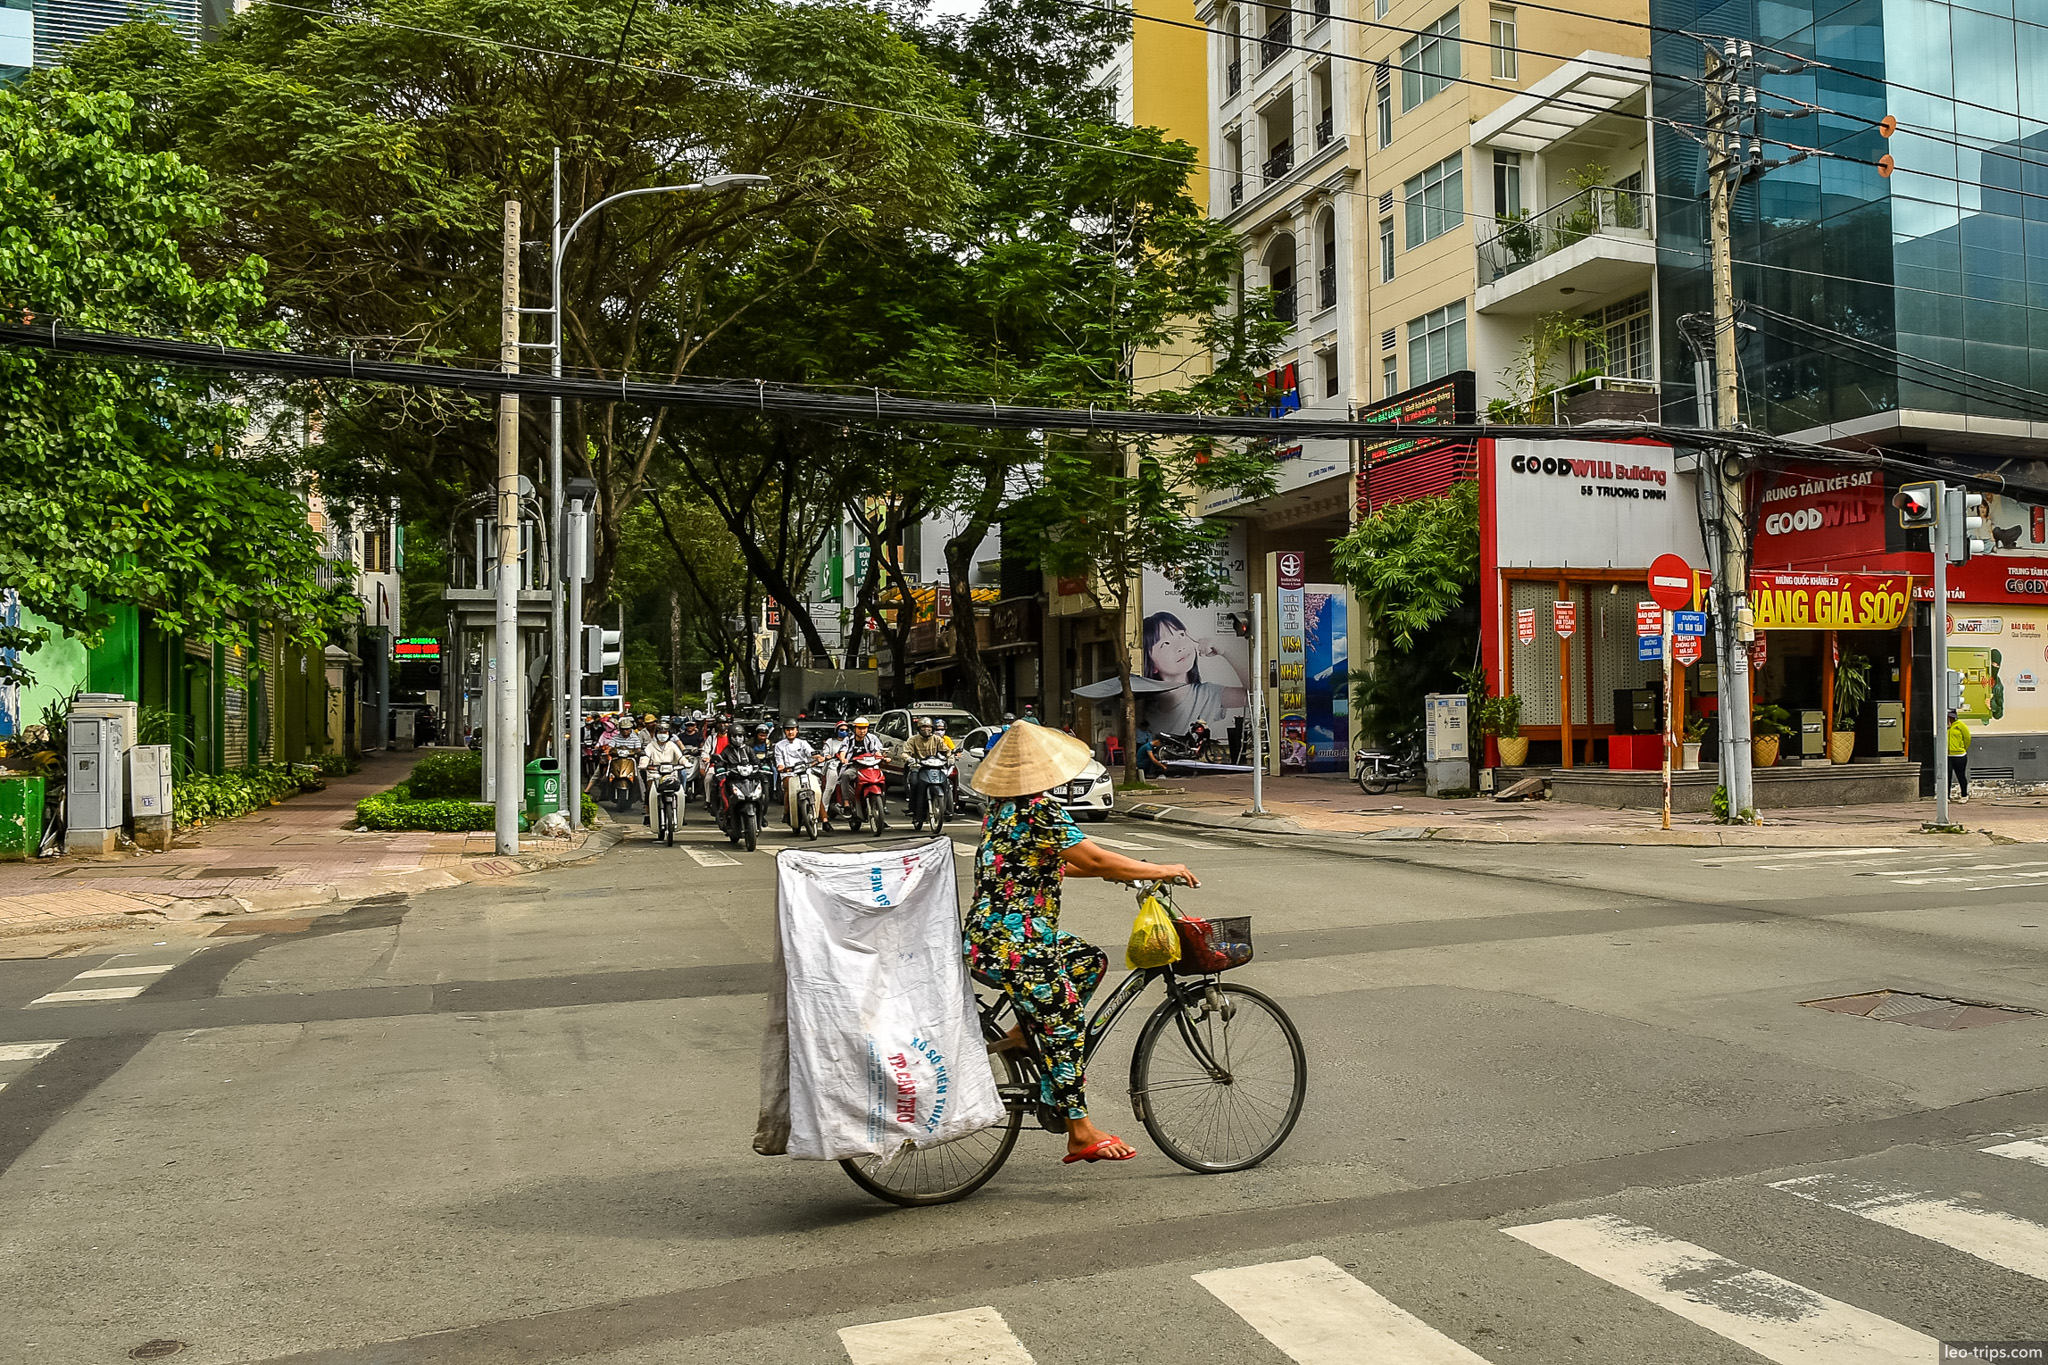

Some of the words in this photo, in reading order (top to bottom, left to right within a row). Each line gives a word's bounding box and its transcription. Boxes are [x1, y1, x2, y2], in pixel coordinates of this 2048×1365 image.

[1511, 455, 1613, 479] GOODWILL
[1615, 464, 1667, 486] Building
[1580, 485, 1593, 496] 55
[1596, 486, 1639, 499] TRUONG
[1642, 489, 1667, 500] DINH
[1765, 501, 1867, 535] GOODWILL
[1814, 583, 1854, 624] GIÁ
[1859, 580, 1904, 624] SỐC
[1281, 635, 1303, 653] VISA
